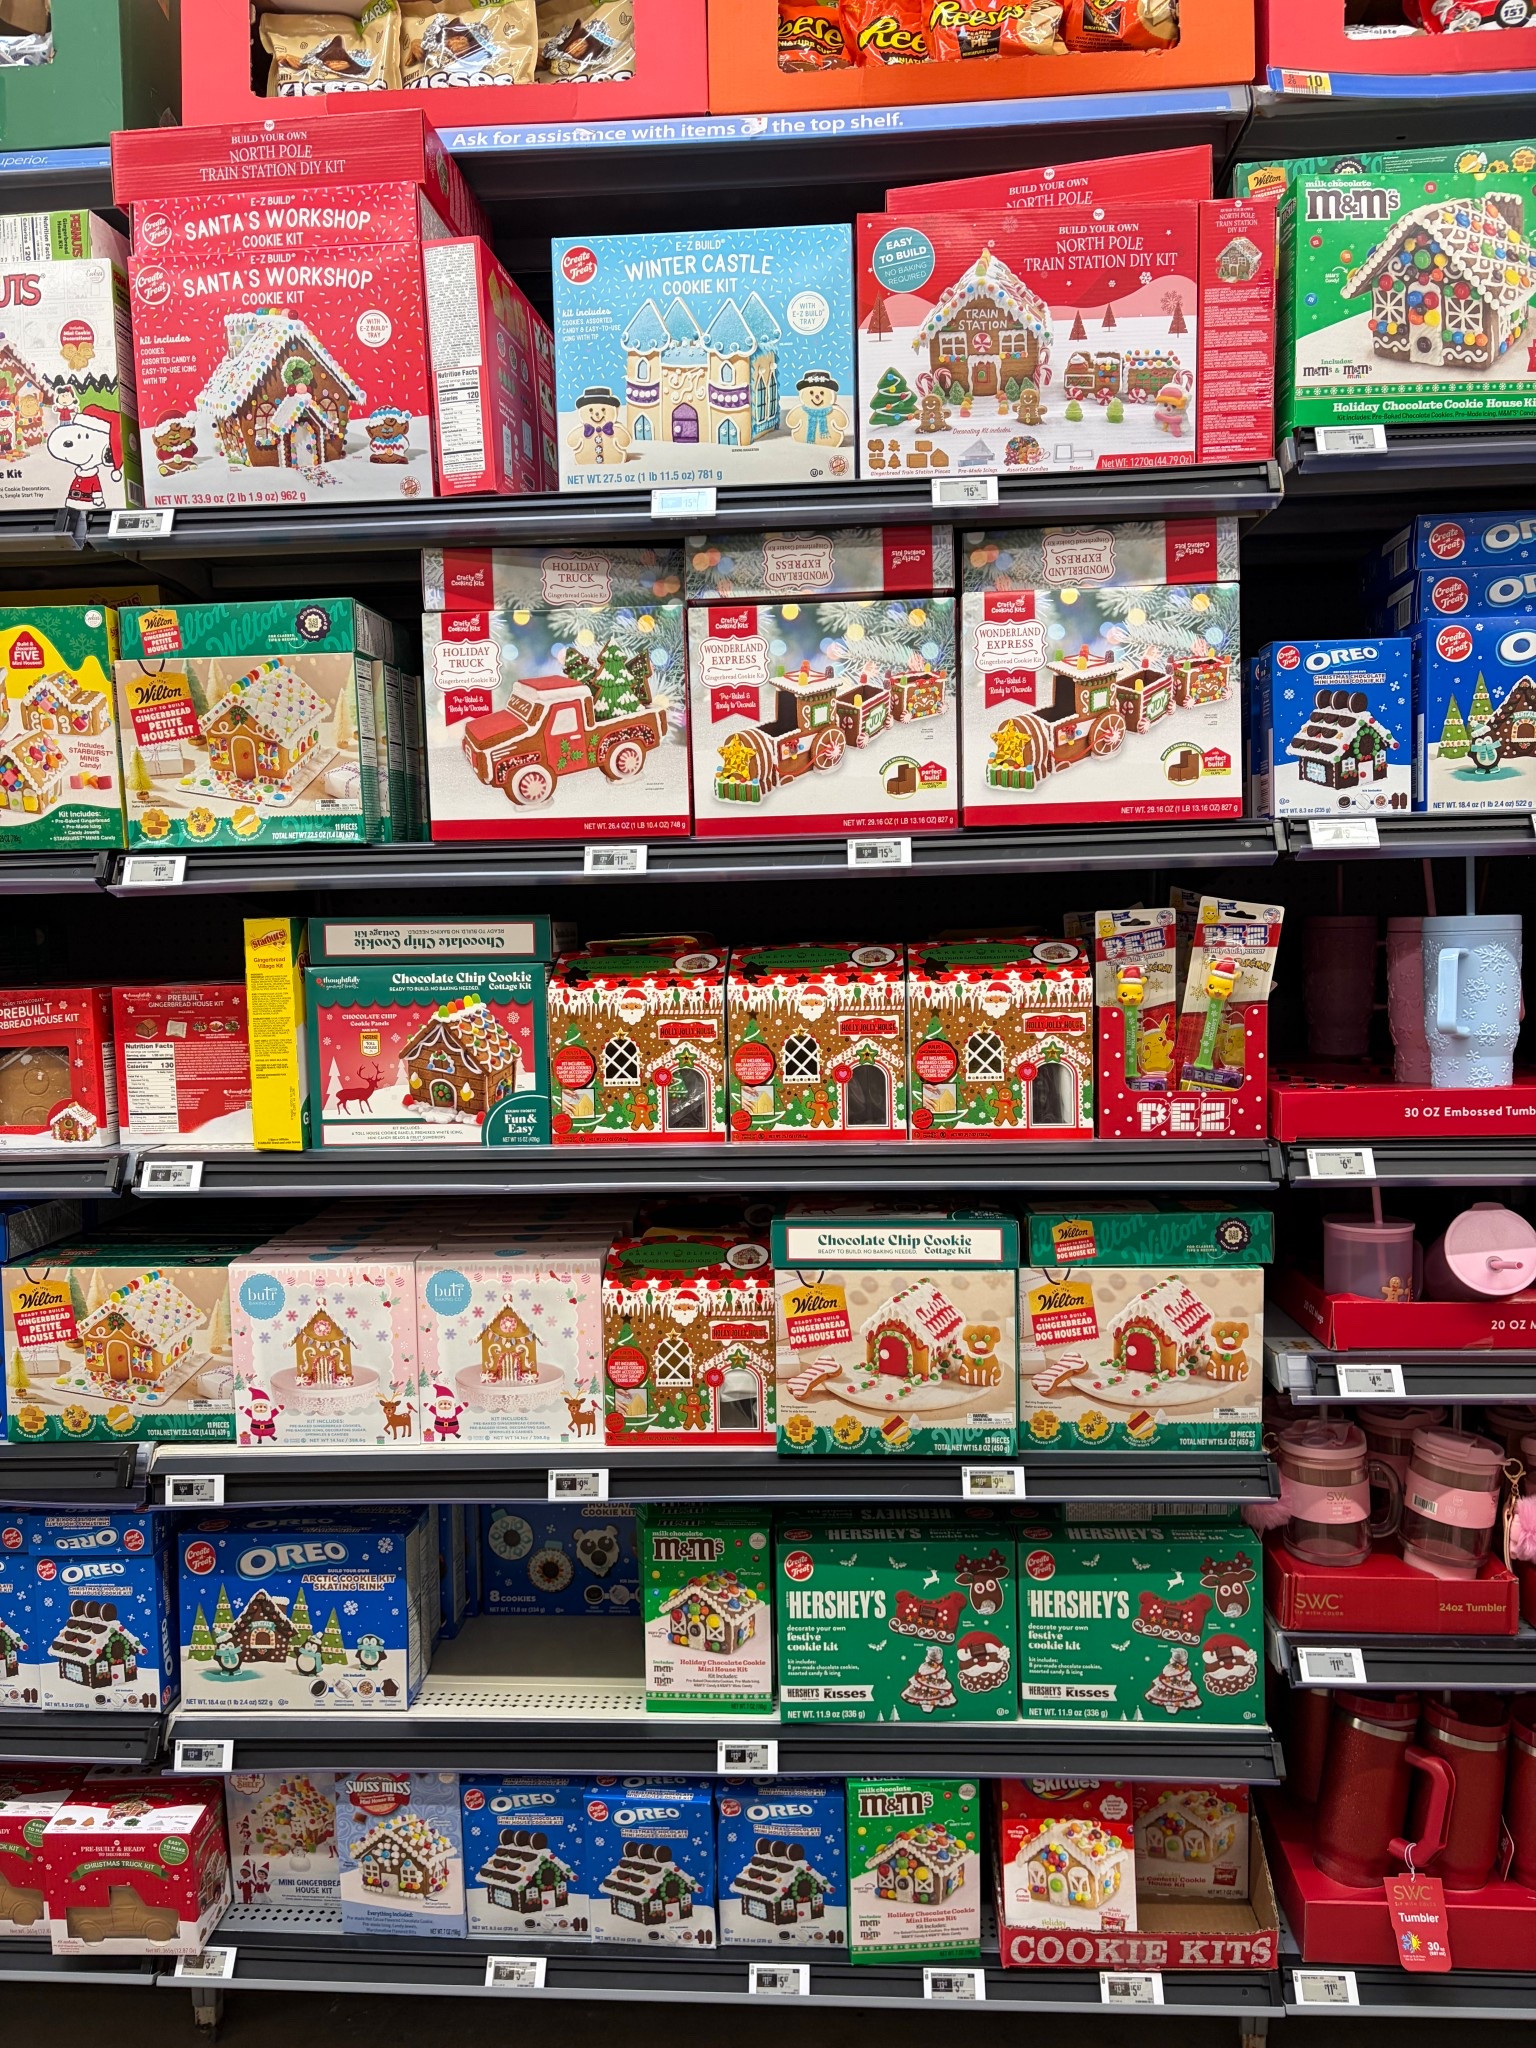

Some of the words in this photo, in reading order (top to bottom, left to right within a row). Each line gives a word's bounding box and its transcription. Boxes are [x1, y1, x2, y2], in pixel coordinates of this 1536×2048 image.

[1504, 8, 1524, 18] 151
[971, 38, 988, 47] PIE
[452, 132, 489, 147] Ask
[493, 129, 521, 145] for
[525, 126, 626, 144] assistance
[631, 122, 676, 141] with
[680, 122, 736, 137] items
[772, 118, 804, 134] the
[809, 115, 846, 135] top
[850, 112, 904, 129] shelf.
[230, 134, 259, 144] BUILD
[262, 132, 284, 143] YOUR
[285, 131, 308, 141] OWN
[229, 147, 274, 164] NORTH
[278, 144, 313, 160] POLE
[200, 167, 239, 182] TRAIN
[241, 163, 297, 180] STATION
[299, 161, 322, 176] DIY
[324, 159, 346, 175] KIT
[1331, 180, 1372, 188] chocolate
[184, 210, 260, 242] SANTA'S
[264, 207, 372, 231] WORKSHOP
[1058, 226, 1088, 235] BUILD
[1089, 225, 1113, 234] YOUR
[1116, 223, 1140, 233] OWN
[70, 213, 82, 258] PEANUTS
[241, 234, 285, 249] COOKIE
[285, 232, 305, 246] KIT
[885, 236, 913, 251] EASY
[1055, 238, 1105, 255] NORTH
[1107, 236, 1144, 251] POLE
[879, 254, 894, 264] TO
[895, 246, 927, 261] BUILD
[1024, 256, 1066, 272] TRAIN
[1068, 254, 1127, 270] STATION
[1129, 254, 1154, 268] DIY
[1155, 252, 1178, 267] KIT
[624, 257, 698, 283] WINTER
[701, 254, 775, 277] CASTLE
[884, 268, 897, 277] NO
[898, 261, 928, 274] BAKING
[182, 267, 261, 299] SANTA'S
[264, 264, 374, 290] WORKSHOP
[887, 271, 927, 286] REQUIRED
[661, 279, 713, 296] COOKIE
[716, 278, 738, 293] KIT
[241, 292, 284, 306] COOKIE
[285, 290, 305, 305] KIT
[1333, 401, 1379, 413] Holiday
[1382, 400, 1442, 411] Chocolate
[1444, 398, 1484, 410] Cookie
[1486, 397, 1523, 409] House
[1101, 460, 1116, 468] Net
[1129, 459, 1154, 470] 1270g
[1153, 456, 1176, 468] (44.79
[1177, 455, 1193, 468] Oz)
[551, 561, 601, 572] HOLIDAY
[557, 573, 596, 583] TRUCK
[978, 626, 1042, 638] WONDERLAND
[147, 645, 169, 654] HOUSE
[169, 642, 179, 651] KIT
[703, 642, 764, 654] WONDERLAND
[986, 638, 1035, 650] EXPRESS
[13, 651, 40, 661] FIVE
[442, 647, 491, 658] HOLIDAY
[1305, 647, 1378, 672] OREO
[448, 658, 485, 669] TRUCK
[711, 655, 757, 666] EXPRESS
[134, 685, 182, 702] Wilton
[135, 707, 191, 723] GINGERBREAD
[148, 718, 184, 731] PETITE
[250, 929, 287, 950] Starburst
[438, 936, 505, 949] Chocolate
[1202, 923, 1271, 947] PEZ
[353, 937, 401, 950] Cookie
[403, 936, 436, 950] Chip
[1102, 927, 1166, 959] PEZ
[323, 976, 361, 986] thoughtfully
[391, 972, 455, 985] Chocolate
[455, 971, 486, 987] Chip
[487, 970, 533, 983] Cookie
[167, 993, 205, 1001] PREBUILT
[160, 1061, 174, 1070] 130
[1136, 1098, 1231, 1132] PEZ
[1404, 1107, 1419, 1119] 30
[1422, 1107, 1440, 1118] OZ
[1444, 1106, 1503, 1118] Embossed
[507, 1123, 535, 1135] Easy
[817, 1234, 885, 1247] Chocolate
[887, 1234, 921, 1250] Chip
[923, 1233, 972, 1247] Cookie
[18, 1291, 64, 1311] Wilton
[247, 1287, 278, 1302] butr
[791, 1295, 839, 1315] Wilton
[1037, 1293, 1086, 1312] Wilton
[17, 1311, 71, 1327] GINGERBREAD
[1035, 1317, 1094, 1332] GINGERBREAD
[29, 1321, 62, 1334] PETITE
[789, 1319, 847, 1335] GINGERBREAD
[239, 1541, 347, 1577] OREO
[61, 1562, 126, 1583] OREO
[489, 1590, 500, 1603] 8
[501, 1594, 537, 1603] COOKIES
[1294, 1593, 1341, 1610] SWC
[789, 1590, 887, 1620] HERSHEY'S
[1030, 1589, 1130, 1620] HERSHEY'S
[1439, 1602, 1464, 1613] 24oz
[1466, 1602, 1507, 1613] Tumbler
[786, 1624, 816, 1633] decorate
[816, 1625, 832, 1634] your
[1028, 1630, 1064, 1642] festive
[786, 1631, 822, 1643] festive
[787, 1709, 802, 1720] NET
[802, 1709, 815, 1719] WT.
[816, 1709, 830, 1719] 11.9
[830, 1710, 840, 1719] oz
[841, 1709, 856, 1720] (336
[857, 1709, 866, 1721] g)
[490, 1793, 556, 1813] OREO
[613, 1807, 680, 1826] OREO
[745, 1803, 813, 1823] OREO
[80, 1845, 115, 1853] PRE-BUILT
[84, 1861, 120, 1870] CHRISTMAS
[121, 1861, 143, 1869] TRUCK
[143, 1862, 155, 1870] KIT
[278, 1878, 293, 1887] MINI
[1398, 1912, 1440, 1924] Tumbler
[1009, 1935, 1168, 1965] COOKIE
[1179, 1936, 1272, 1967] KITS
